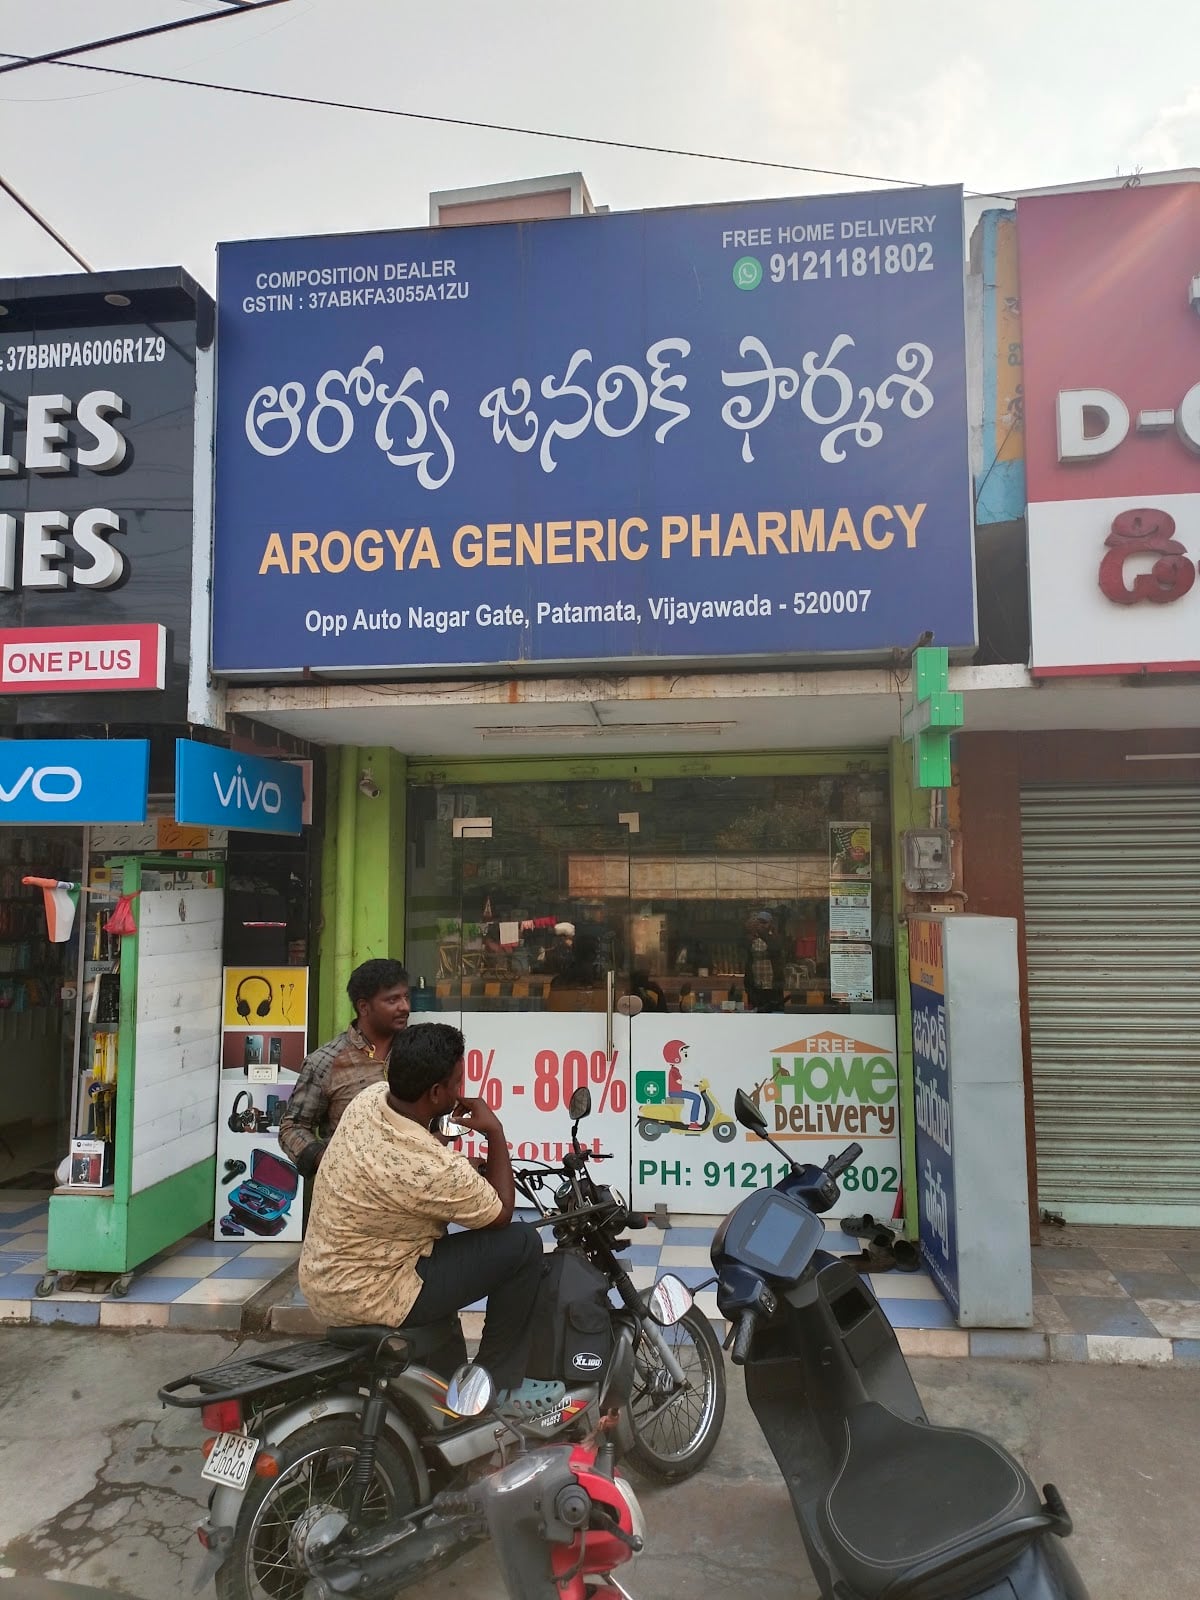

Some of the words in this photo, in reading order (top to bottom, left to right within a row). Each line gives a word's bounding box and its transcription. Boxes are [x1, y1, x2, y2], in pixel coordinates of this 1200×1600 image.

[722, 228, 772, 248] FREE
[778, 222, 834, 243] HOME
[840, 215, 937, 239] DELIVERY
[255, 265, 379, 290] COMPOSITION
[384, 259, 457, 281] DEALER
[769, 242, 934, 283] 9121181802
[242, 294, 293, 314] GSTIN
[308, 281, 470, 310] 37ABKFA3055A1ZU
[6, 336, 166, 371] 37BBNPA6006R1Z9
[245, 345, 455, 490] ఆరోగ్య
[479, 337, 691, 473] జనరిక్
[721, 333, 935, 464] ఫార్మశి
[258, 526, 441, 575] AROGYA
[452, 516, 650, 569] GENERIC
[661, 503, 927, 559] PHARMACY
[305, 609, 348, 637] Opp
[352, 608, 402, 631] Auto
[408, 606, 470, 634] Nagar
[475, 603, 530, 629] Gate,
[537, 602, 641, 625] Patamata,
[648, 593, 772, 626] Vijayawada
[793, 589, 872, 616] 520007
[213, 764, 282, 814] vivo
[806, 1038, 855, 1053] FREE
[533, 1049, 627, 1113] 80%
[638, 1159, 691, 1186] PH:
[703, 1161, 899, 1193] 91211802
